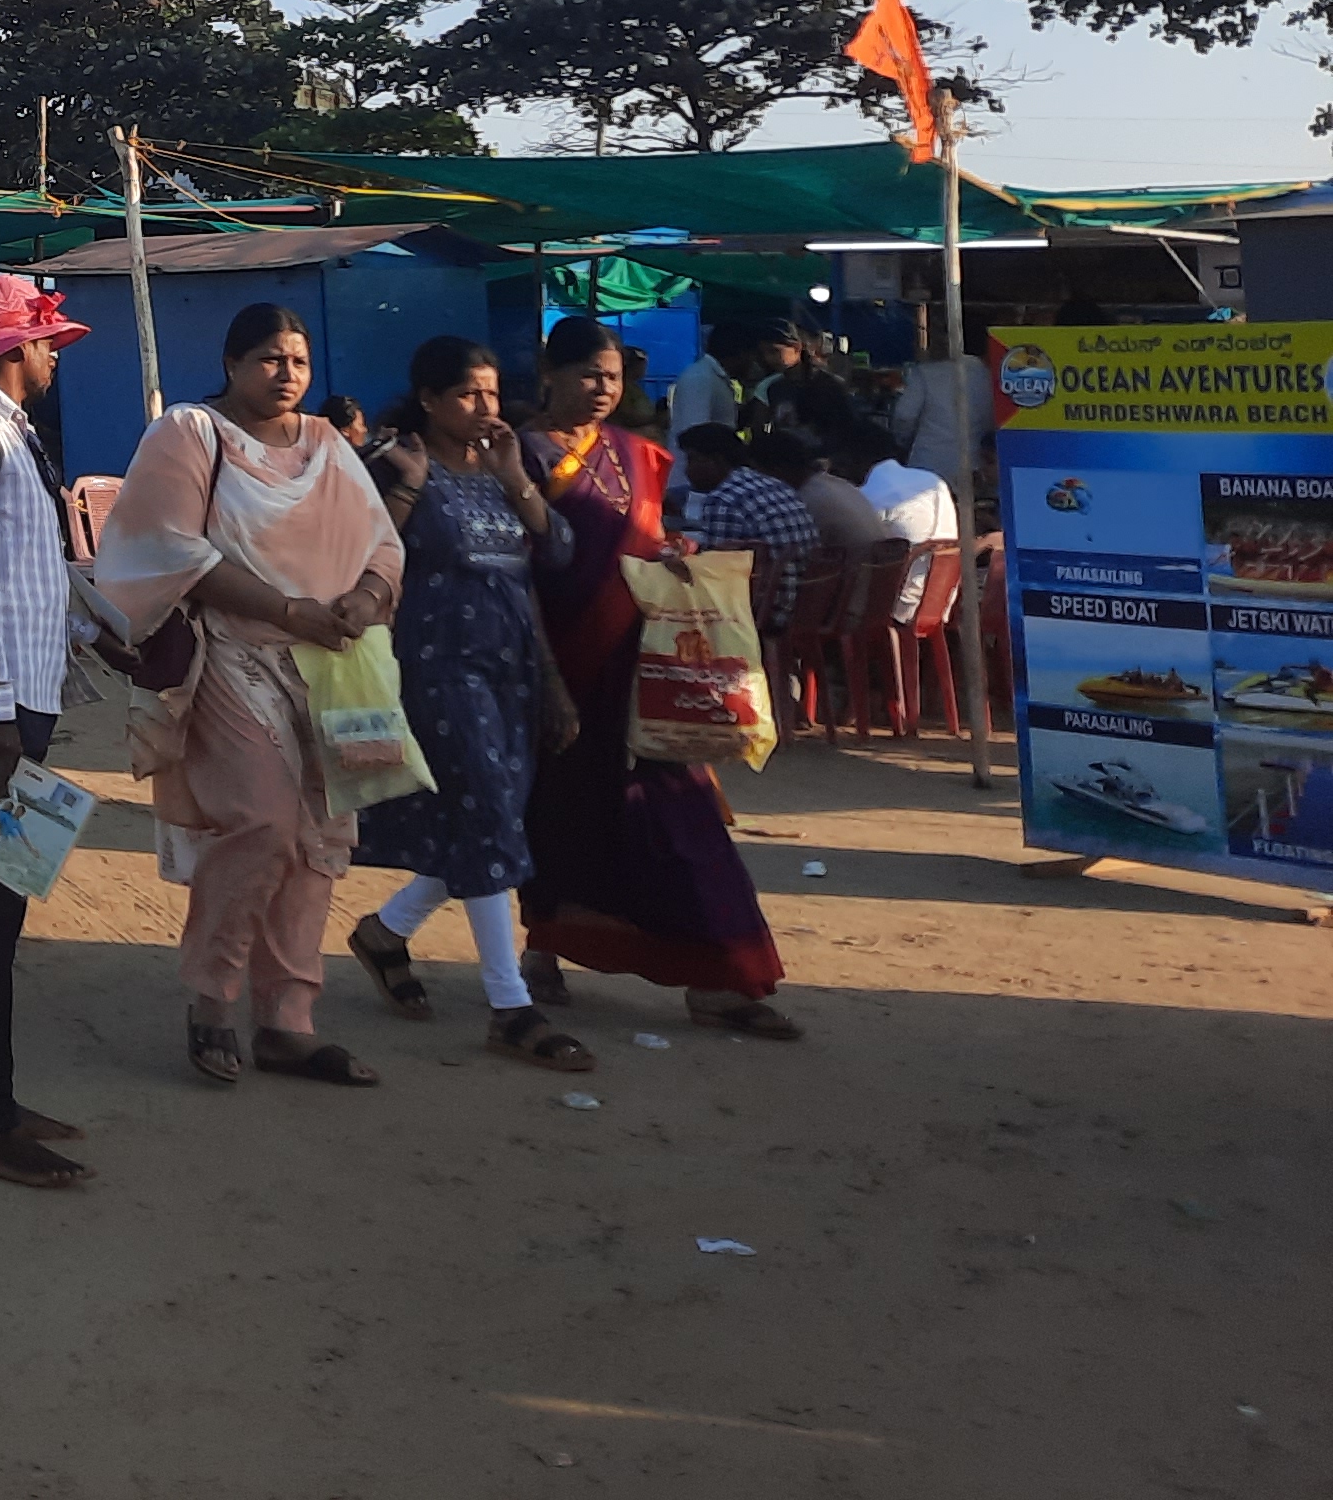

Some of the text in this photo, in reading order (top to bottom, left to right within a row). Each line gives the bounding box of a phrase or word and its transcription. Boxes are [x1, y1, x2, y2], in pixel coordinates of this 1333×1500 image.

[1001, 378, 1056, 396] OCEAN
[1062, 364, 1326, 394] OCEAN AVENTURES
[1064, 403, 1328, 423] MURDESHWARA BEACH
[1219, 477, 1293, 498] BANANA
[1056, 565, 1143, 586] PARASAILING
[1050, 595, 1158, 623] SPEED BOAT
[1228, 609, 1333, 635] JETSKI WAT
[1064, 711, 1153, 737] PARASAILING
